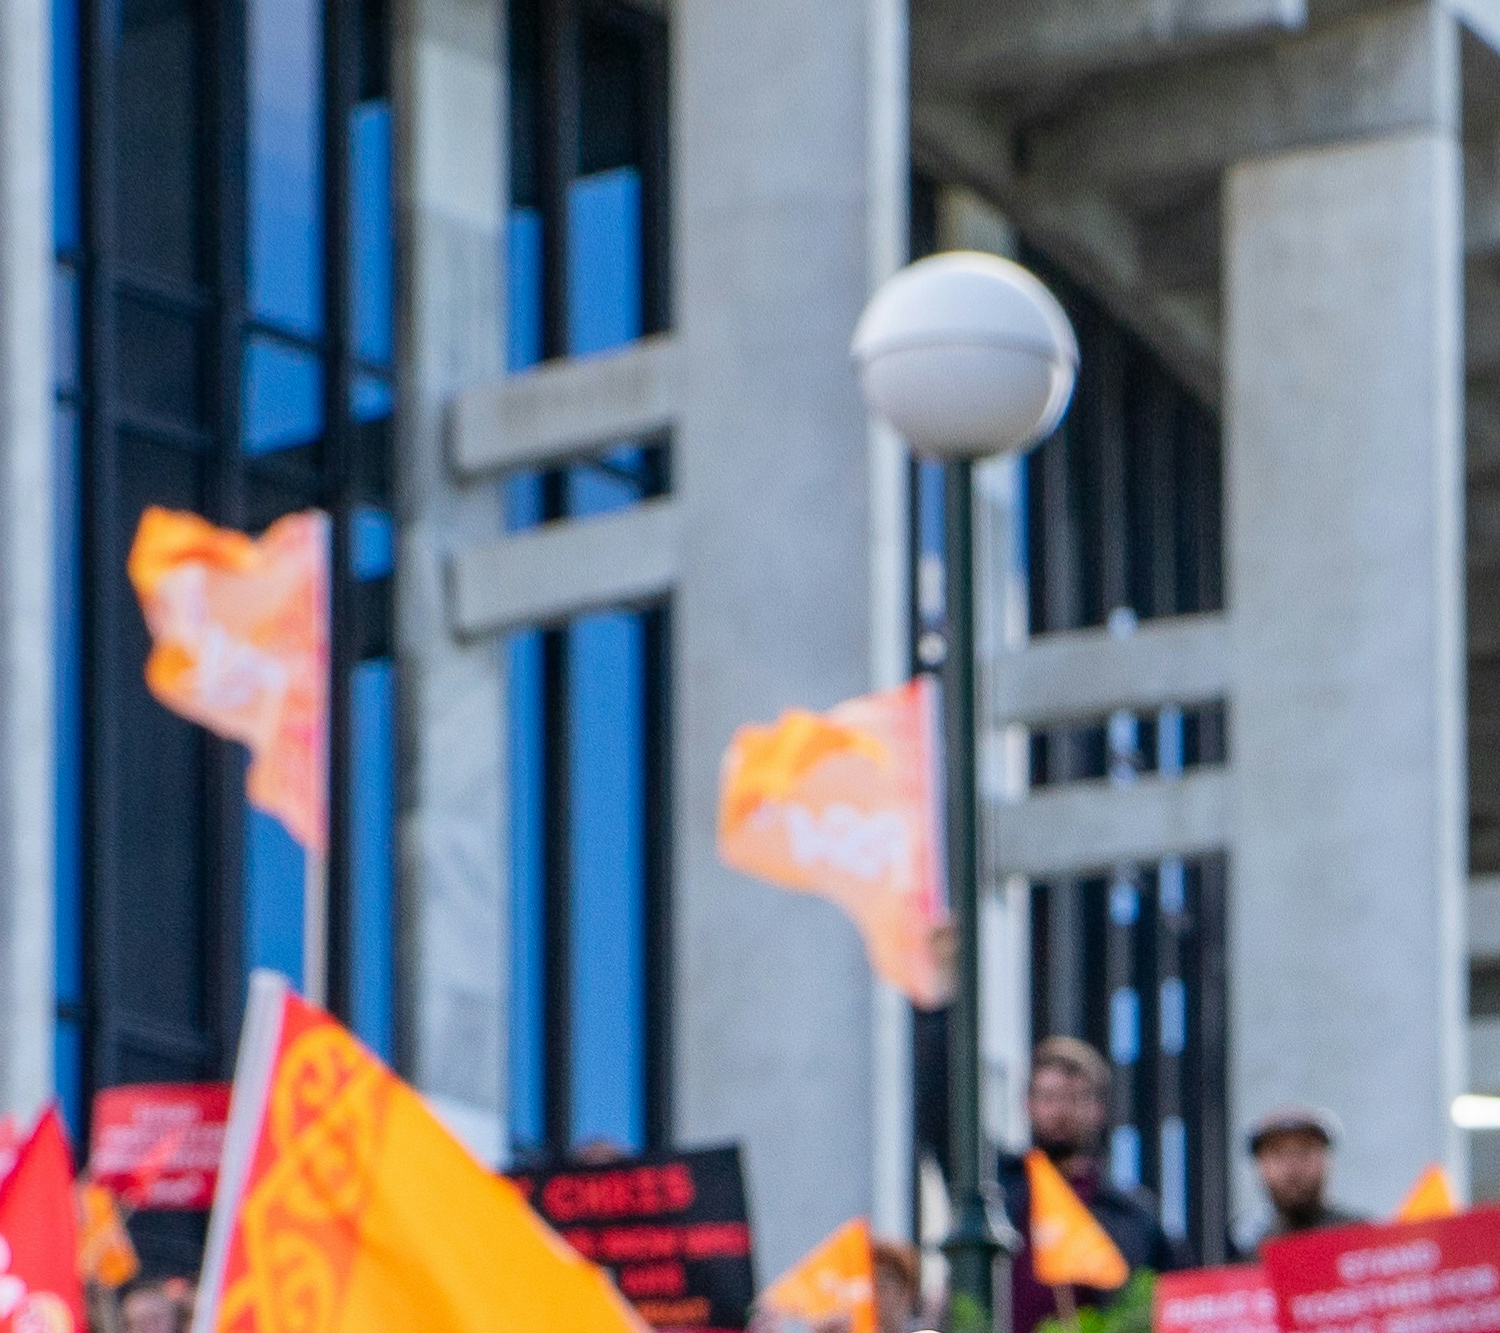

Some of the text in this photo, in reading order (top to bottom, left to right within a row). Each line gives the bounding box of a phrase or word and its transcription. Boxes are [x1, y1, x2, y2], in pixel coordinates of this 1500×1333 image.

[1339, 1241, 1439, 1281] STAND
[1294, 1277, 1437, 1325] TOGETHER
[1440, 1268, 1499, 1299] FOR
